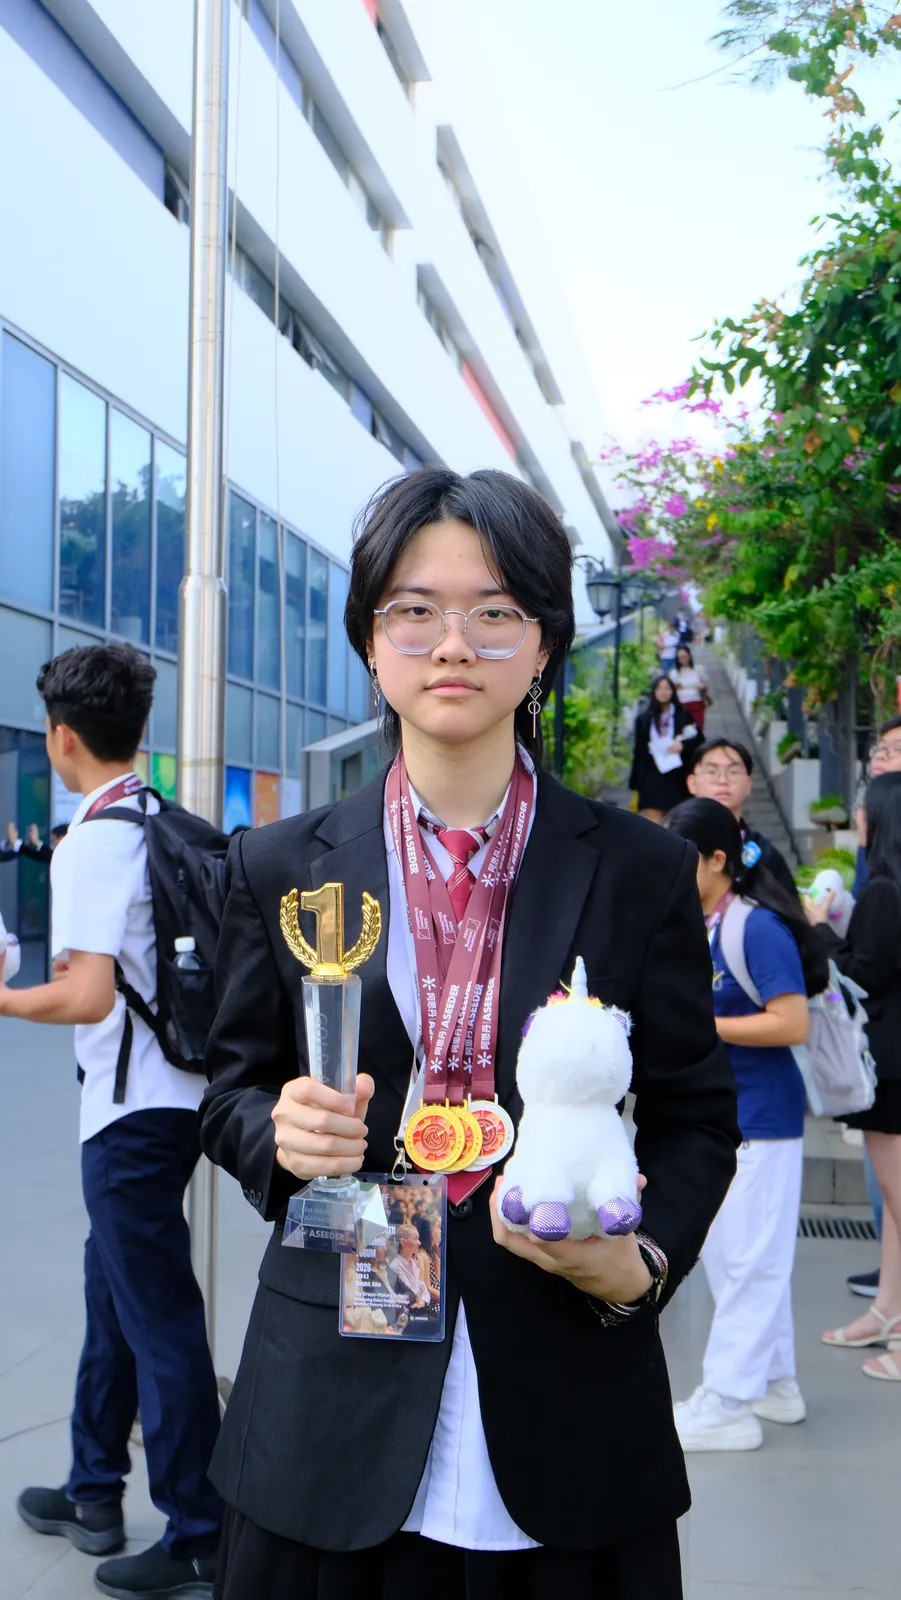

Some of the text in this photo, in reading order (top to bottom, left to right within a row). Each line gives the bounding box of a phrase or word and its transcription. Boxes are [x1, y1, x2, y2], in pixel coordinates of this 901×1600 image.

[516, 800, 528, 841] ASEEDER
[405, 835, 419, 875] ASEEDER
[422, 850, 436, 881] EDER
[434, 984, 460, 1056] 阿思丹 ASEEDER
[468, 983, 484, 1027] ASEEDER
[481, 977, 495, 1050] 阿思丹 ASEEDER
[309, 1229, 344, 1241] ASEEDER
[356, 1249, 376, 1258] ORUM
[356, 1263, 371, 1272] 2026
